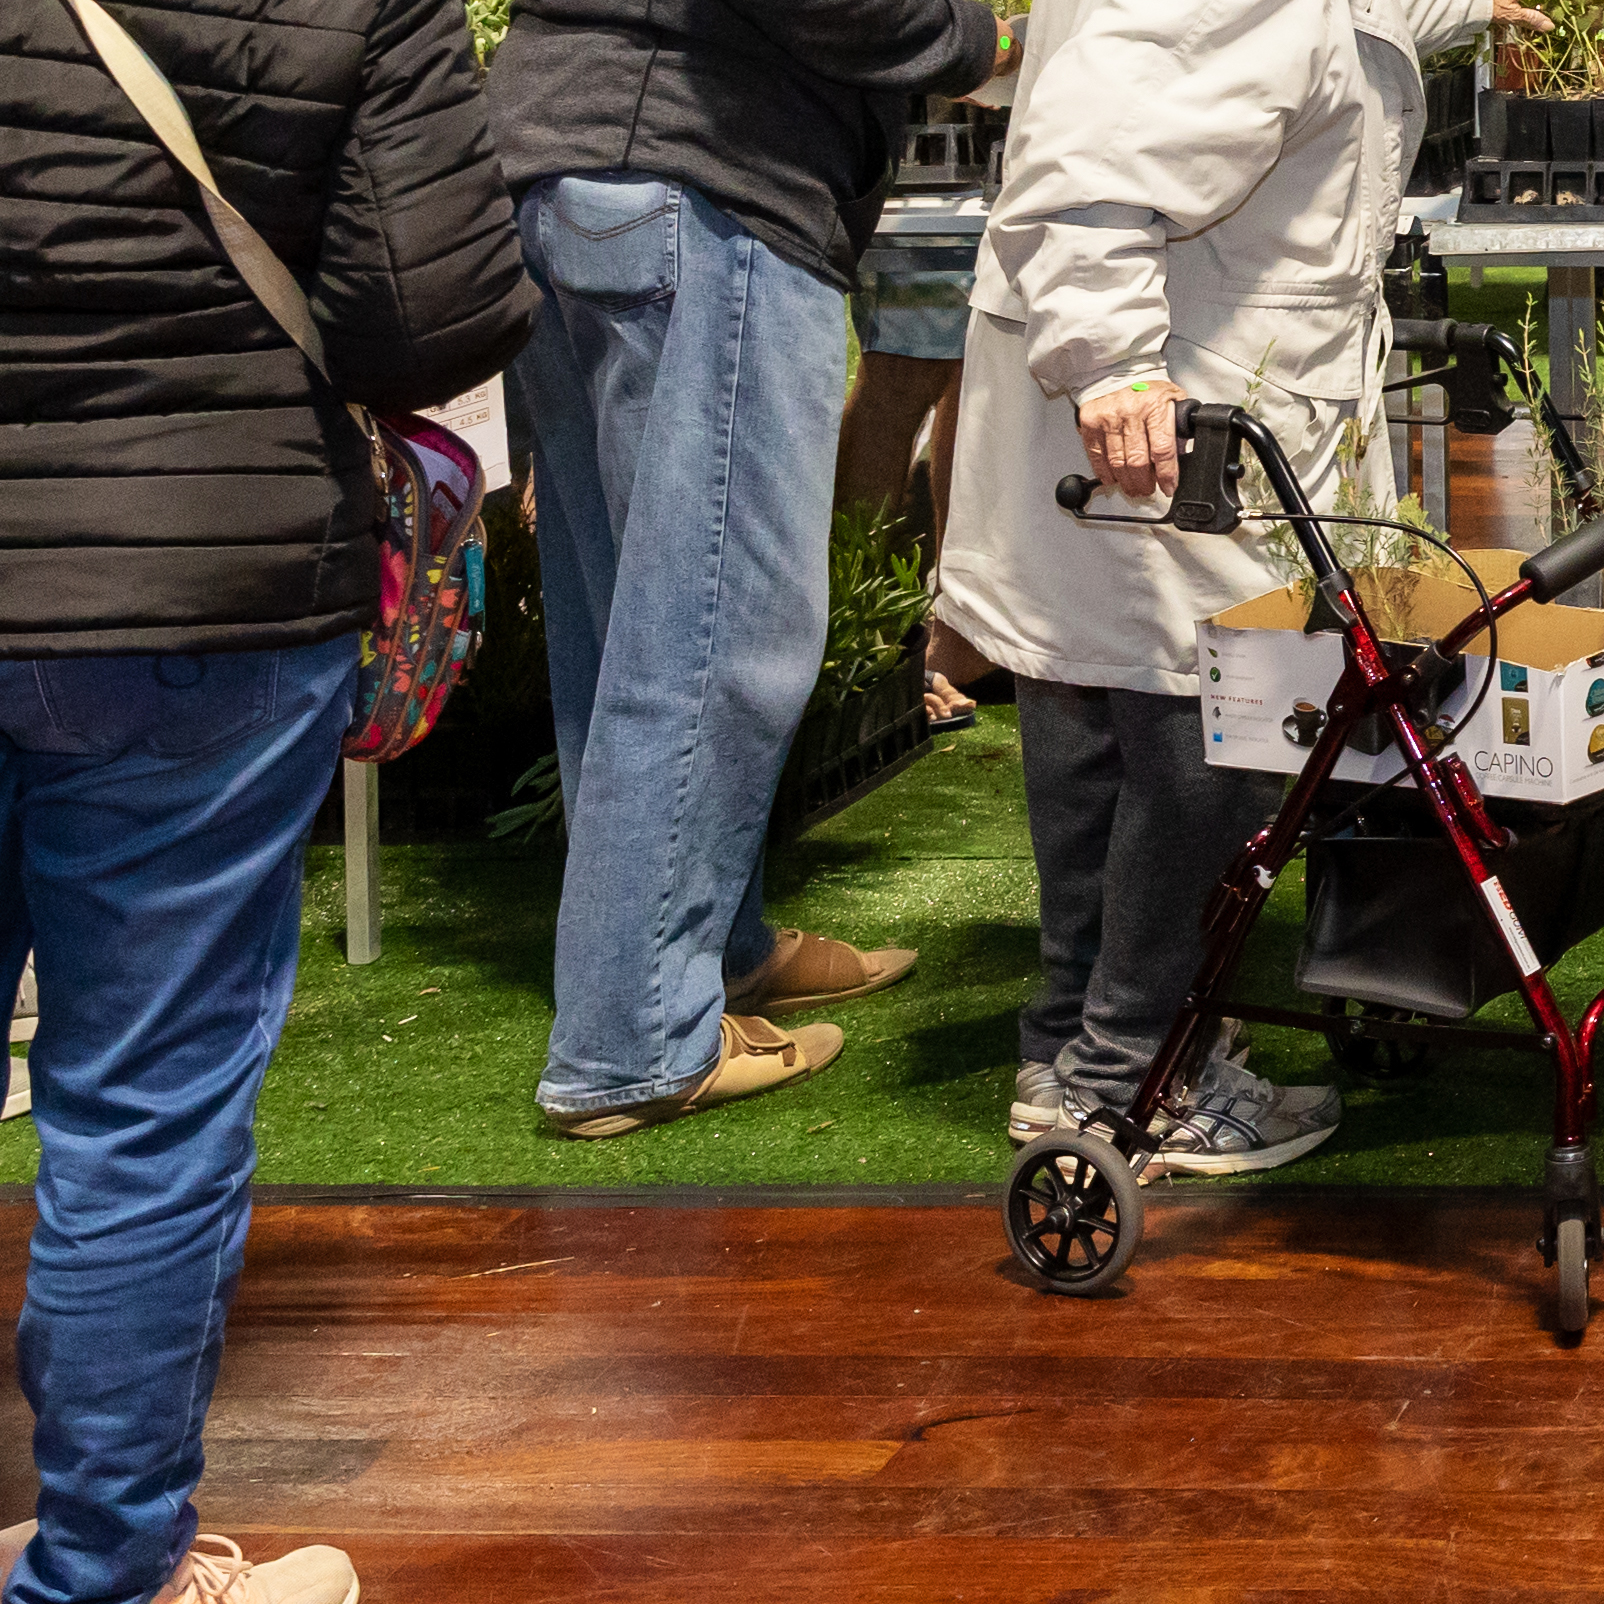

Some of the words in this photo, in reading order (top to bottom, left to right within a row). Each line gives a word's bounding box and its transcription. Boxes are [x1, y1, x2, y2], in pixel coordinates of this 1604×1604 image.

[459, 416, 474, 426] 4.5
[476, 411, 488, 420] KG
[1210, 693, 1226, 701] NEW
[1228, 696, 1263, 706] FEATURES
[1474, 750, 1554, 778] CAPINO
